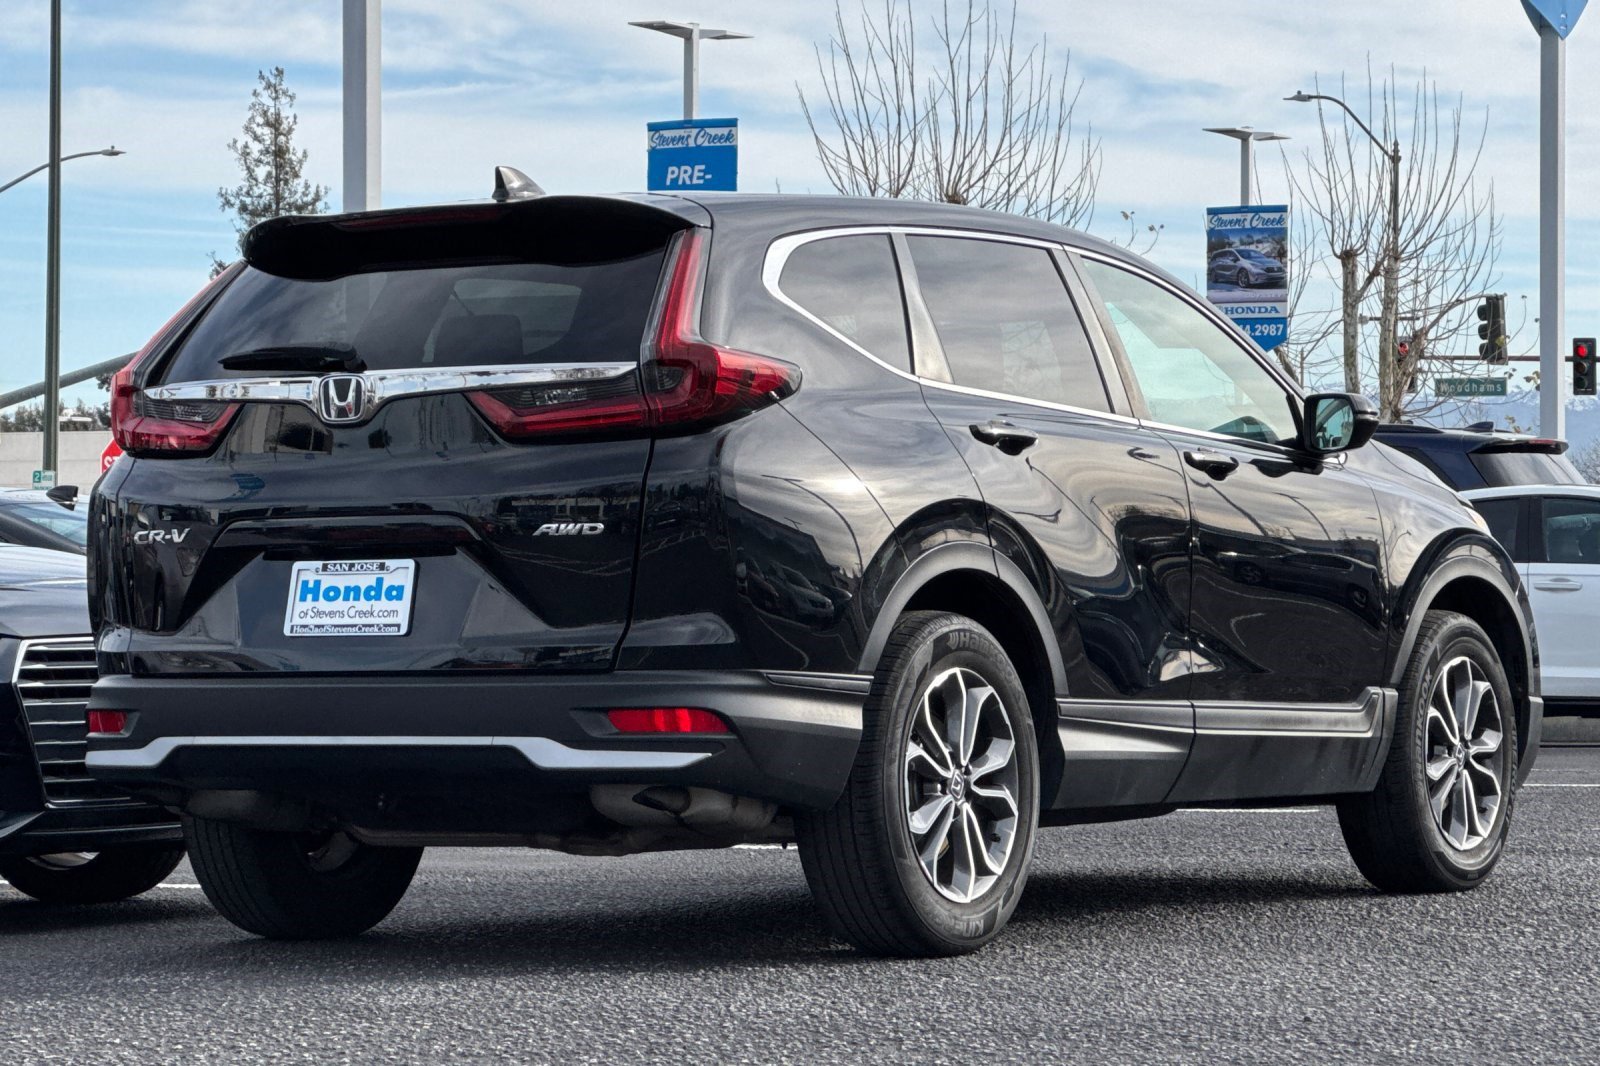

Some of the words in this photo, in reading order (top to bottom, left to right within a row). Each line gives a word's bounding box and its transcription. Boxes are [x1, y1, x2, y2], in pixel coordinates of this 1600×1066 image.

[650, 130, 693, 149] Stevens
[694, 128, 736, 146] Creek
[666, 164, 712, 185] PRE-
[1209, 214, 1246, 230] Stevens
[1249, 213, 1287, 227] Creek
[1224, 305, 1281, 315] HONDA
[34, 472, 40, 482] 2
[133, 527, 191, 545] CR-V
[532, 522, 605, 537] AWD
[326, 563, 349, 572] SAN
[351, 562, 381, 571] JOSE
[298, 576, 405, 602] Honda
[298, 608, 310, 619] of
[310, 606, 345, 619] Stevens
[346, 604, 399, 619] Creek.com
